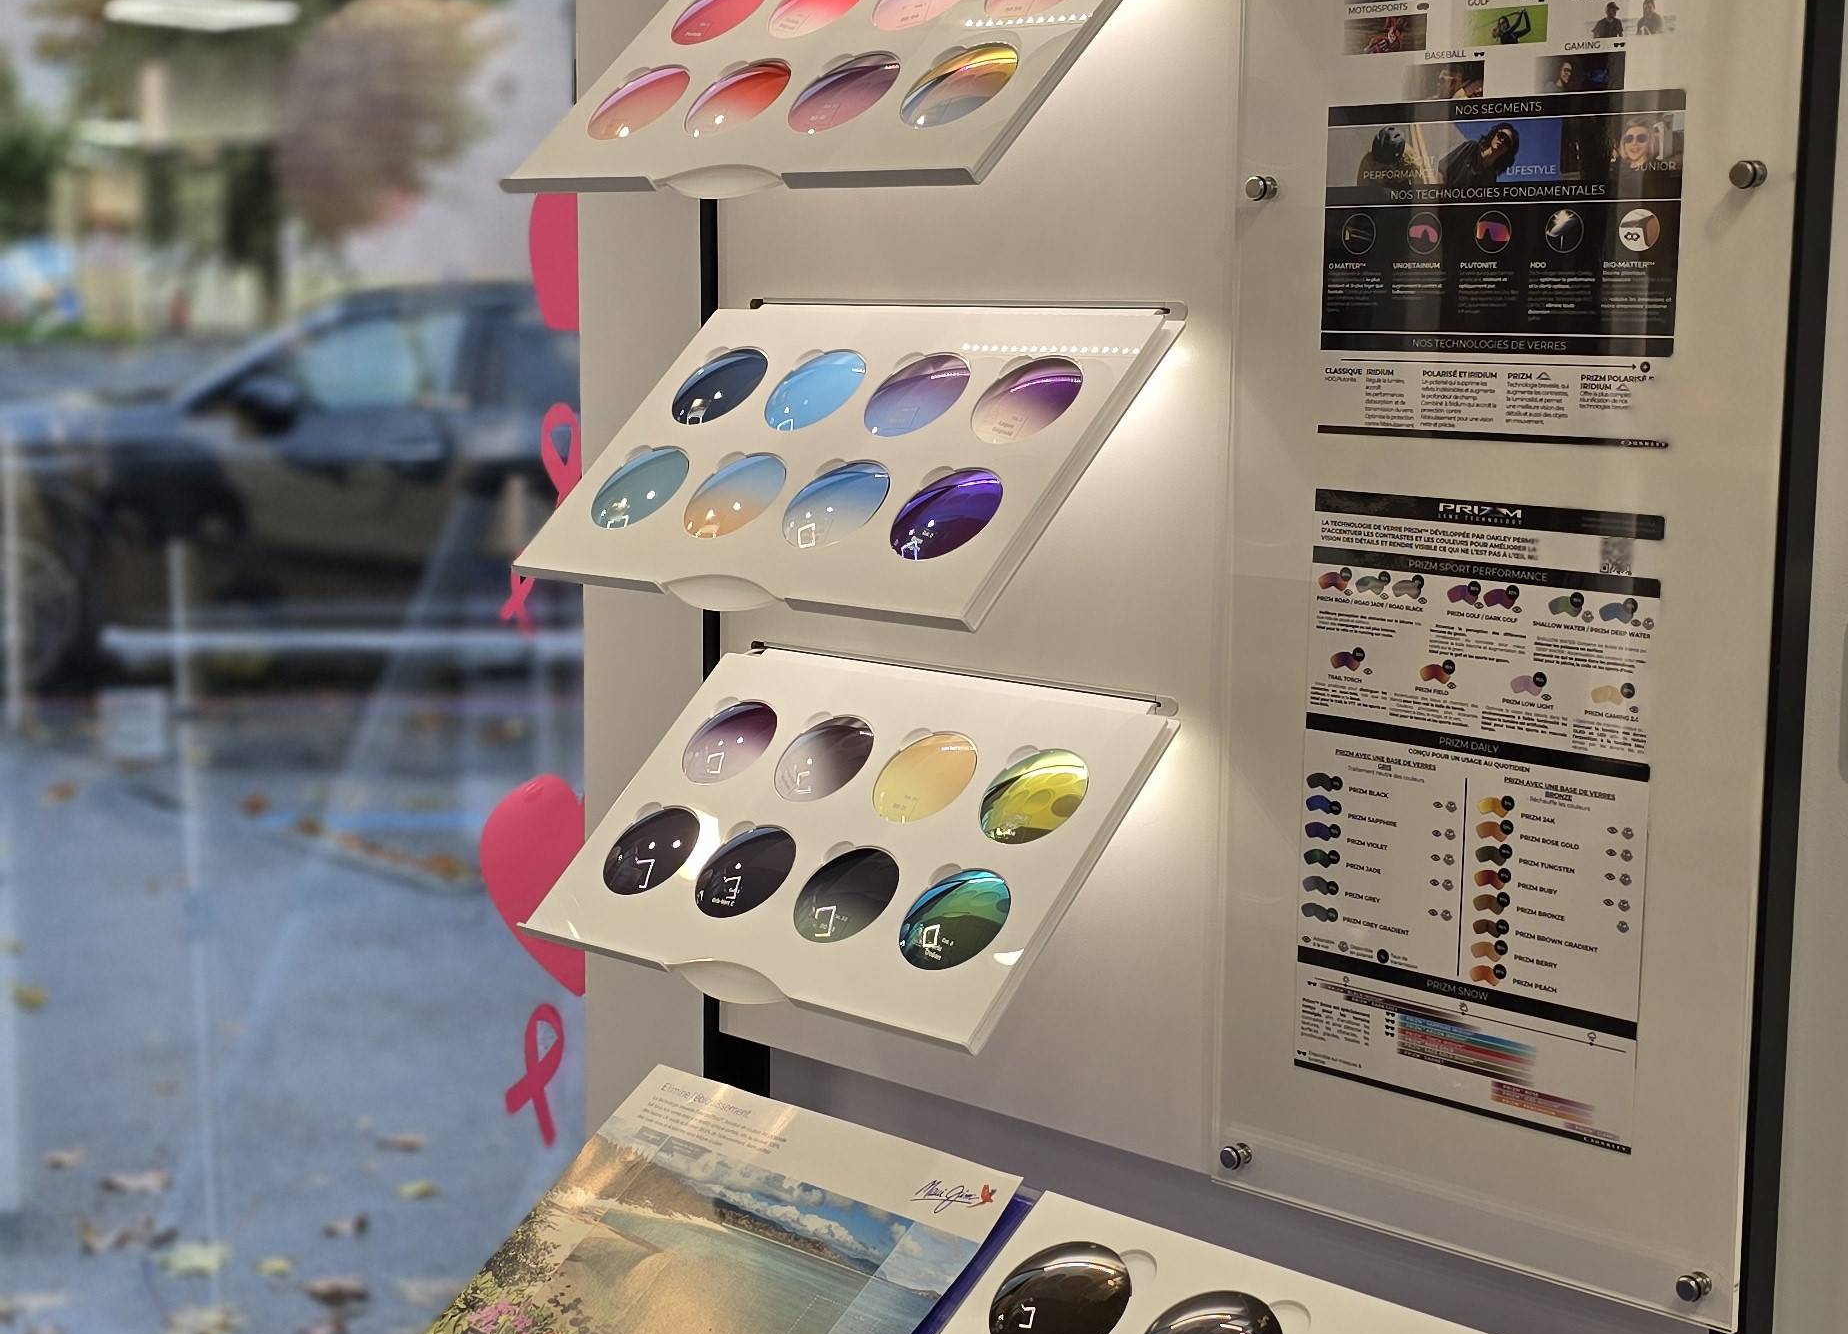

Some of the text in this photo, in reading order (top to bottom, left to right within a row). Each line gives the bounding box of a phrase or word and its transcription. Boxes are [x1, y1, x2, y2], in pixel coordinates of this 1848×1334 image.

[1348, 2, 1408, 15] MOTORSPORTS
[1564, 41, 1601, 51] GAMING
[1424, 50, 1467, 60] BASEBALL
[1455, 101, 1542, 115] NOS SEGMENTS
[1506, 164, 1557, 176] LIFESTYLE
[1634, 161, 1677, 172] JUNIOR
[1390, 184, 1605, 200] NOS TECHNOLOGIES FONDAMENTALES
[1412, 339, 1567, 350] NOS TECHNOLOGIES DE VERRES
[1325, 367, 1362, 376] CLASSIQUE
[1507, 372, 1532, 380] PRIZM
[1438, 502, 1522, 518] PRIZM
[1408, 559, 1548, 582] PRIZM SPORT PERFORMANCE
[1415, 686, 1449, 696] PRIZM FIELD
[1439, 736, 1500, 754] PRIZM DAILY
[1408, 748, 1530, 773] CONÇU POUR UN USAGE AU QUOTIDIEN
[1348, 786, 1389, 799] PRIZM BLACK
[1346, 837, 1388, 851] PRIZM VIOLET
[1519, 834, 1580, 850] PRIZM ROSE GOLD
[1518, 858, 1575, 874] PRIZM TUNGSTEN
[1344, 891, 1380, 904] PRIZM GREY
[1515, 930, 1598, 953] PRIZM BROWN GRADIENT
[1514, 954, 1557, 968] PRIZM BERRY
[1426, 979, 1489, 1000] PRIZM SNOW
[1512, 978, 1557, 993] PRIZM PEACH
[910, 1179, 980, 1214] Maui Jim
